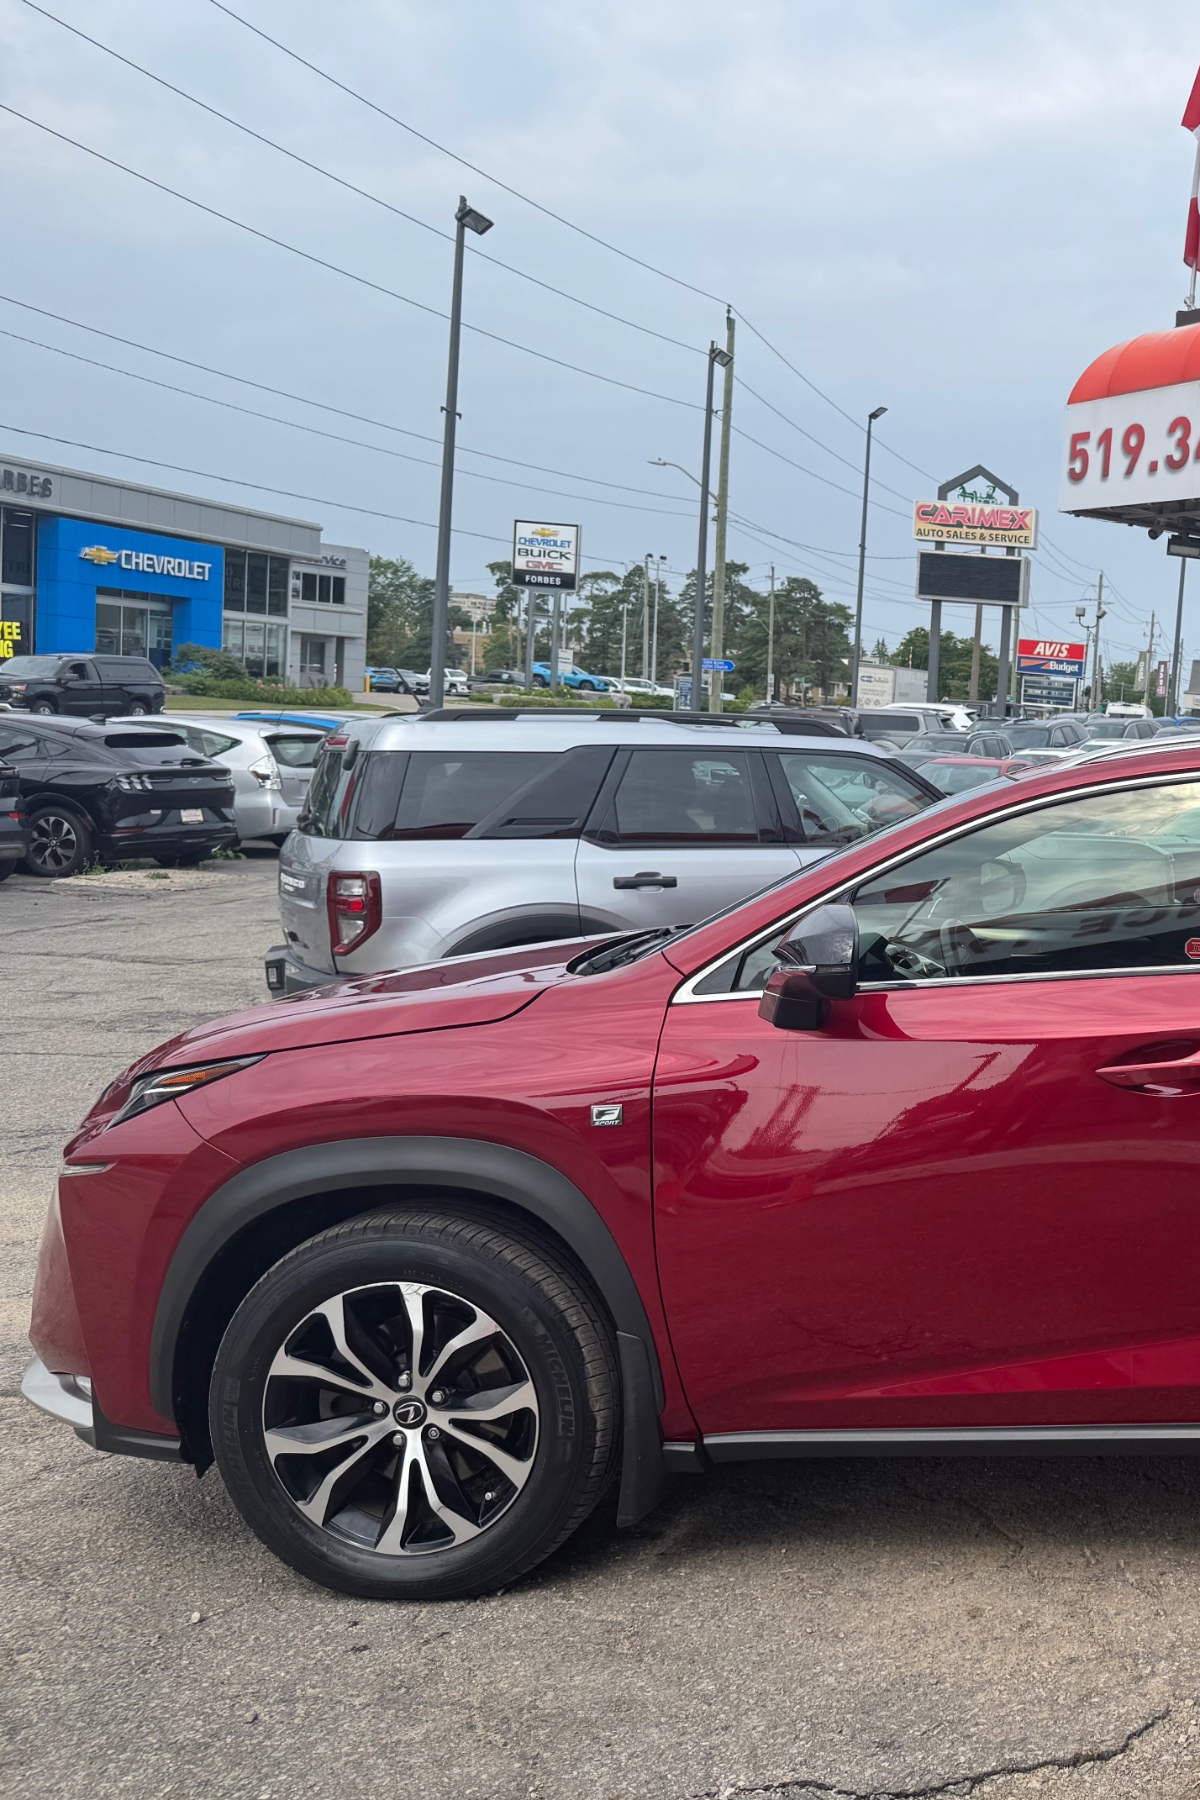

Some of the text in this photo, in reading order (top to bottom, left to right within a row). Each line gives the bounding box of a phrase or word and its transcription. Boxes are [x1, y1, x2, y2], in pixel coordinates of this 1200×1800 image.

[0, 469, 52, 498] RBES
[915, 503, 1032, 529] CARIMEX
[518, 537, 573, 549] CHEVROLET
[916, 528, 1030, 544] AUTO SALES & SERVICE
[517, 547, 572, 560] BUICK
[121, 549, 212, 581] CHEVROLET
[526, 560, 563, 571] GMC
[525, 574, 561, 586] FORBES
[1033, 642, 1069, 657] AVIS
[1050, 661, 1079, 673] Budget
[537, 1333, 575, 1437] MICHELIN
